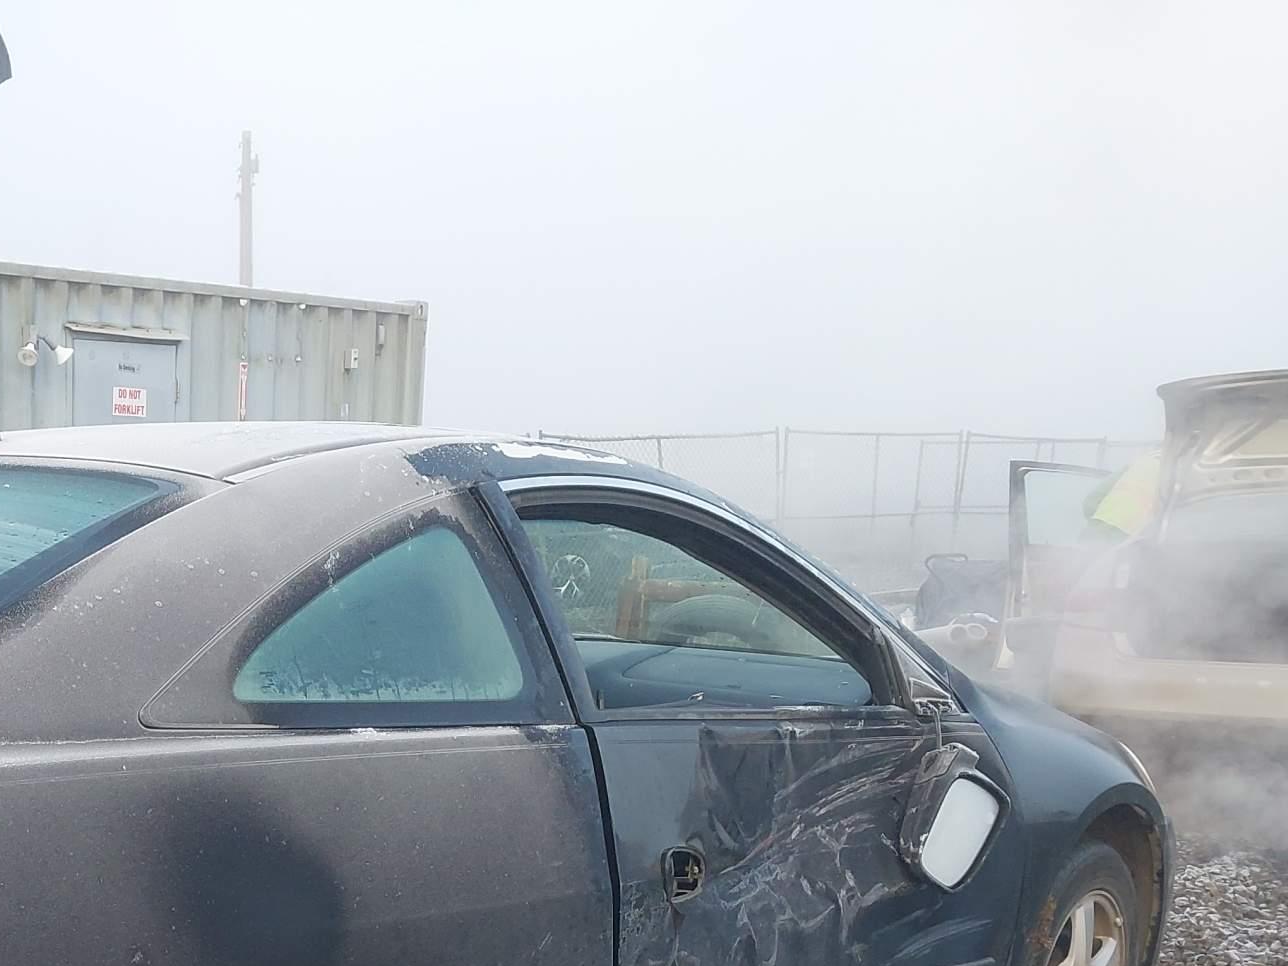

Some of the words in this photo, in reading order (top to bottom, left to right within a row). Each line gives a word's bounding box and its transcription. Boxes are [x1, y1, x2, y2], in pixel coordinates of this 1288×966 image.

[118, 388, 127, 399] DO
[128, 389, 142, 400] NOT
[114, 403, 145, 416] FORKLIFT
